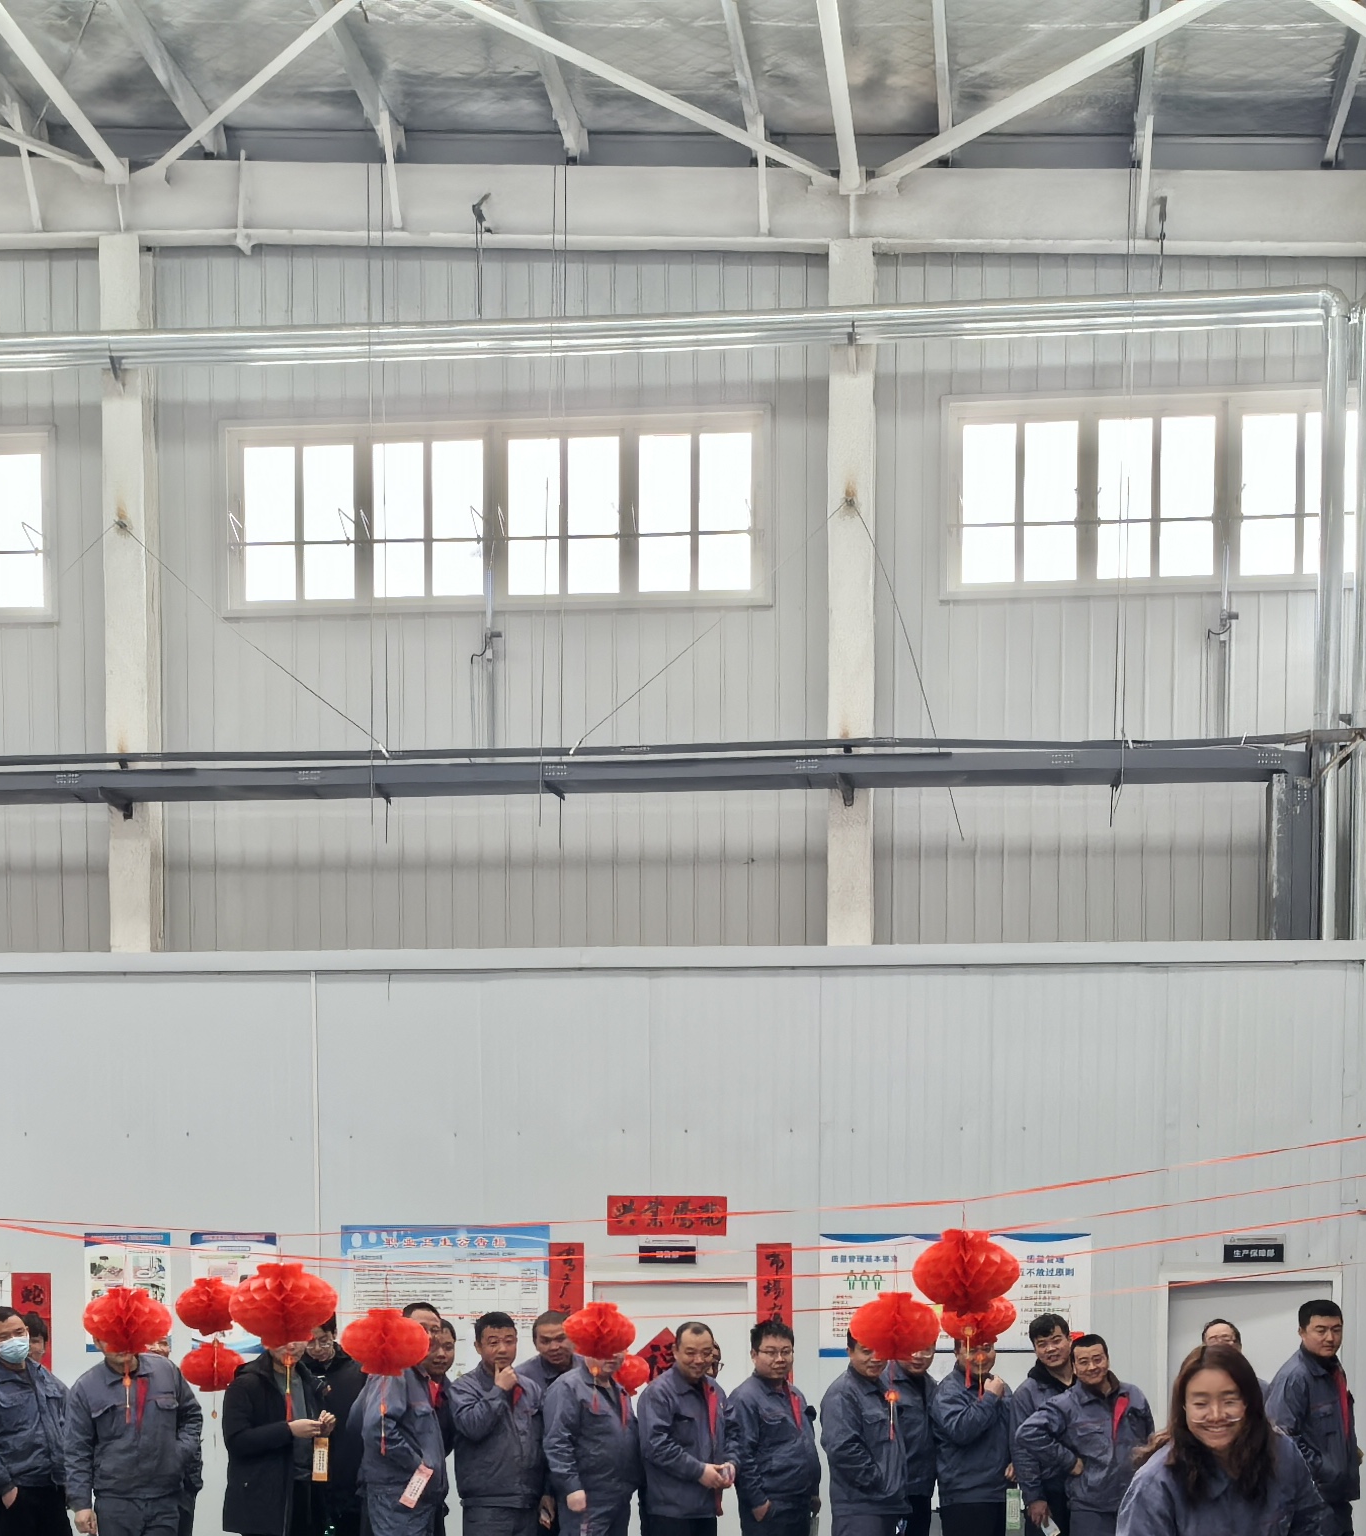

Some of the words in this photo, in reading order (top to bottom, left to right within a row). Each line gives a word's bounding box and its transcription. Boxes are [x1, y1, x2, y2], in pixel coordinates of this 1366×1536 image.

[383, 1236, 508, 1249] 职业卫生公告栏
[1233, 1248, 1276, 1258] 生产保障部
[1026, 1254, 1065, 1264] 质量管理
